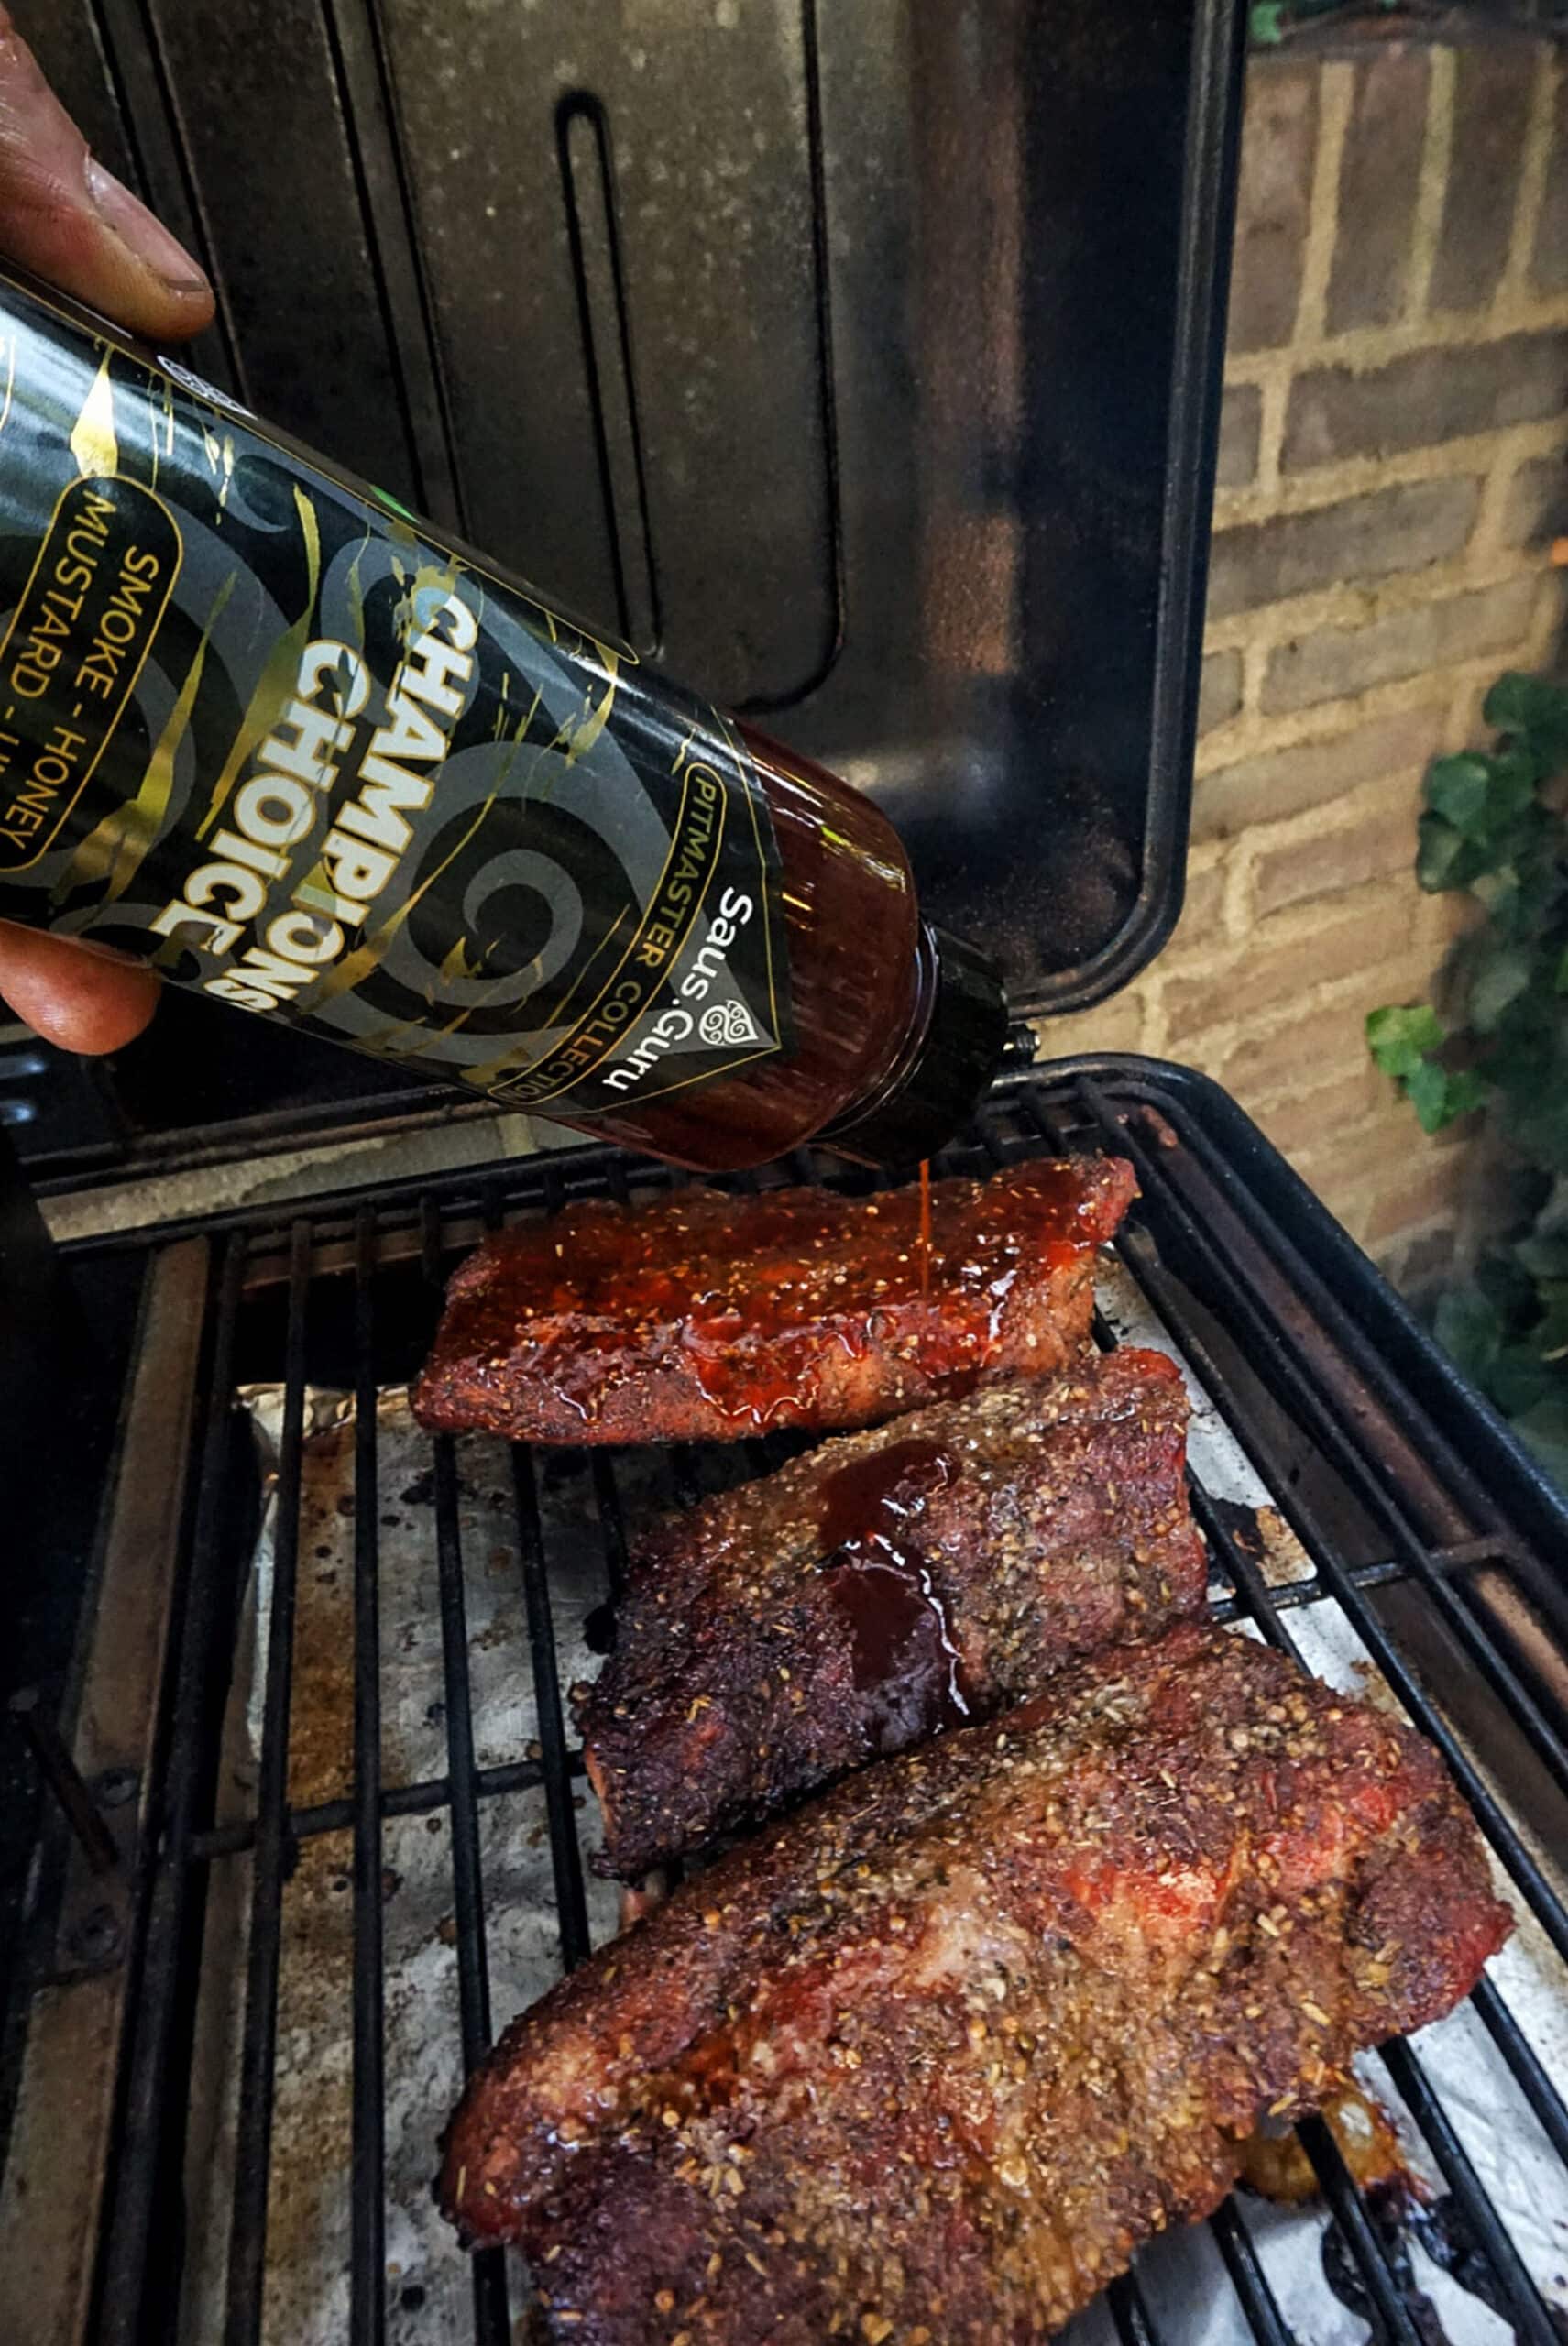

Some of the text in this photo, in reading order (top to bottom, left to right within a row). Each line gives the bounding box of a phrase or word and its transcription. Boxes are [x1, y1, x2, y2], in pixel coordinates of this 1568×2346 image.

[11, 489, 117, 698] MUSTARD
[74, 545, 159, 699] SMOKE
[0, 726, 87, 850] HONEY
[148, 639, 370, 956] CHOICE
[203, 587, 478, 1013] CHAMPIONS
[636, 778, 717, 968] PITMASTER
